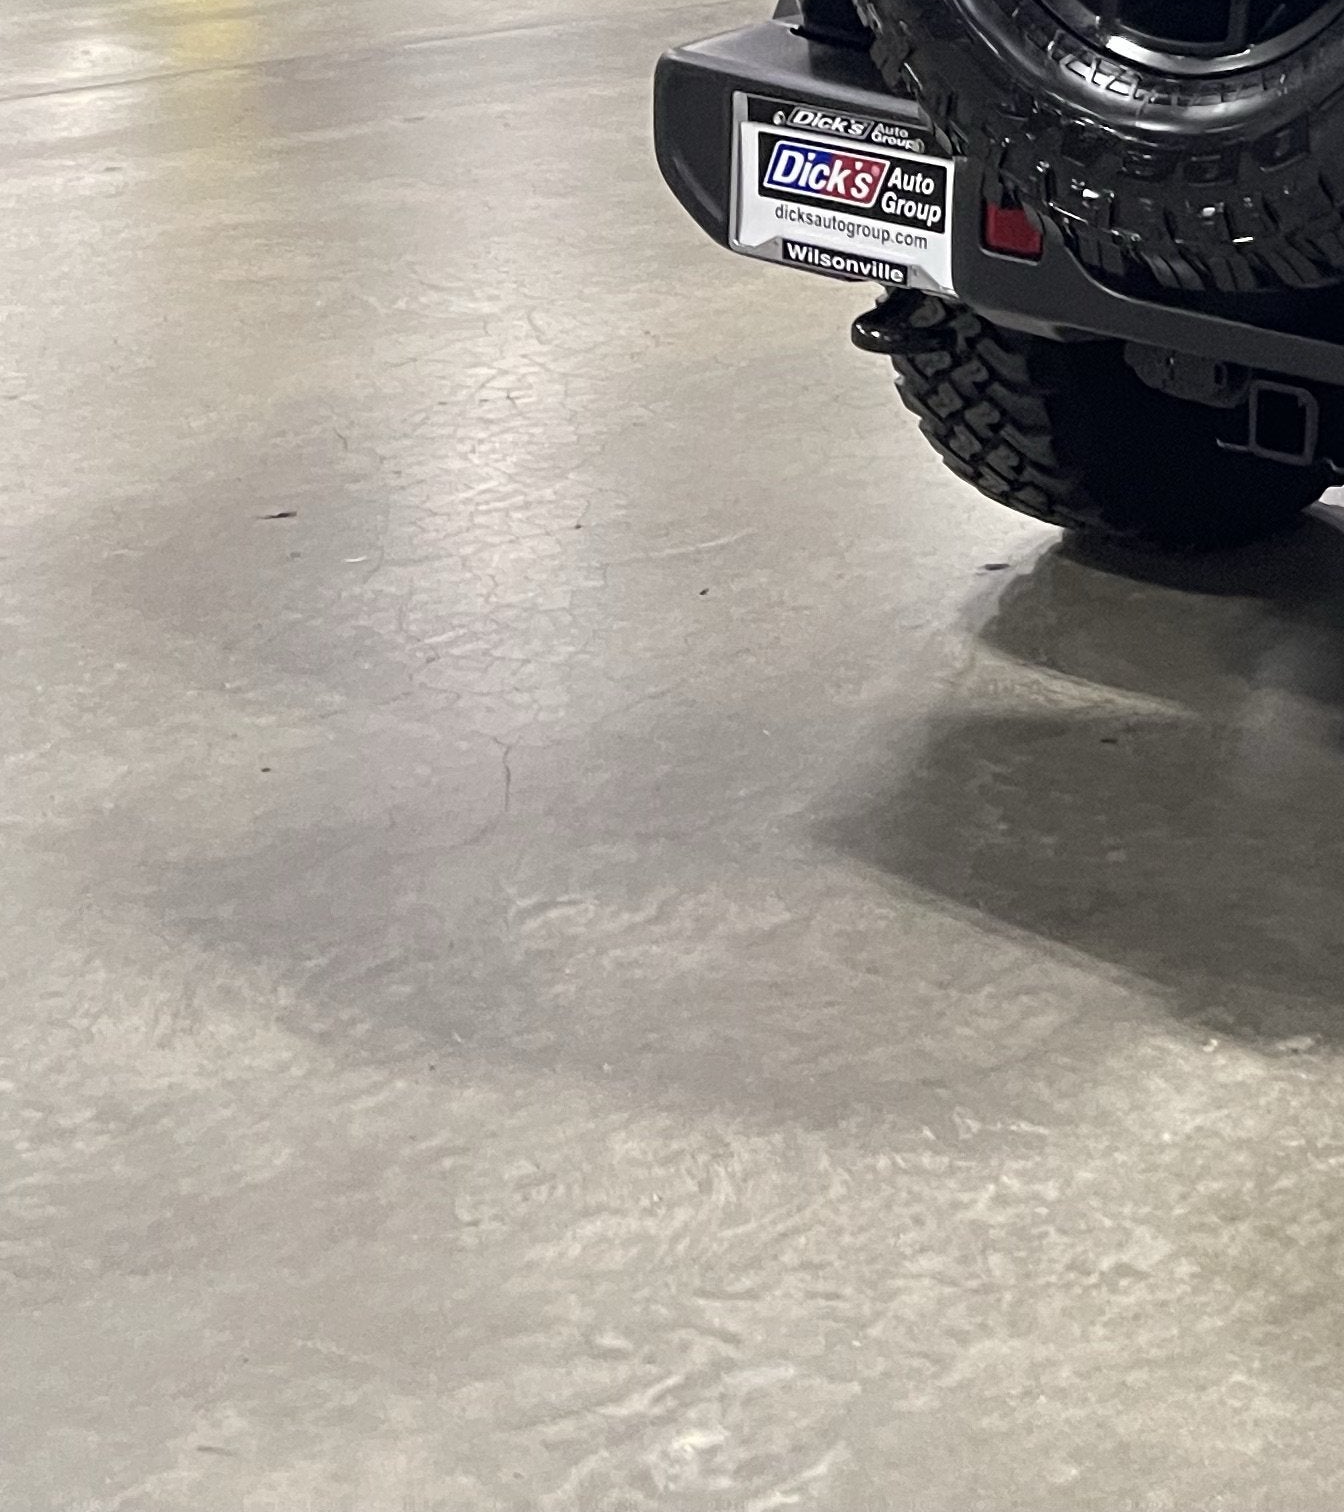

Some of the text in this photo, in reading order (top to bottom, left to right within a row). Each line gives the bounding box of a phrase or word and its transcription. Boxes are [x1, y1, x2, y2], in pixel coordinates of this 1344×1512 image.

[792, 110, 866, 136] Dick's
[876, 123, 909, 138] Auto
[772, 149, 873, 199] Dick's
[887, 167, 935, 195] Auto
[775, 204, 928, 250] dicksautogroup.com
[881, 191, 942, 227] Group
[786, 241, 904, 283] Wilsonville
